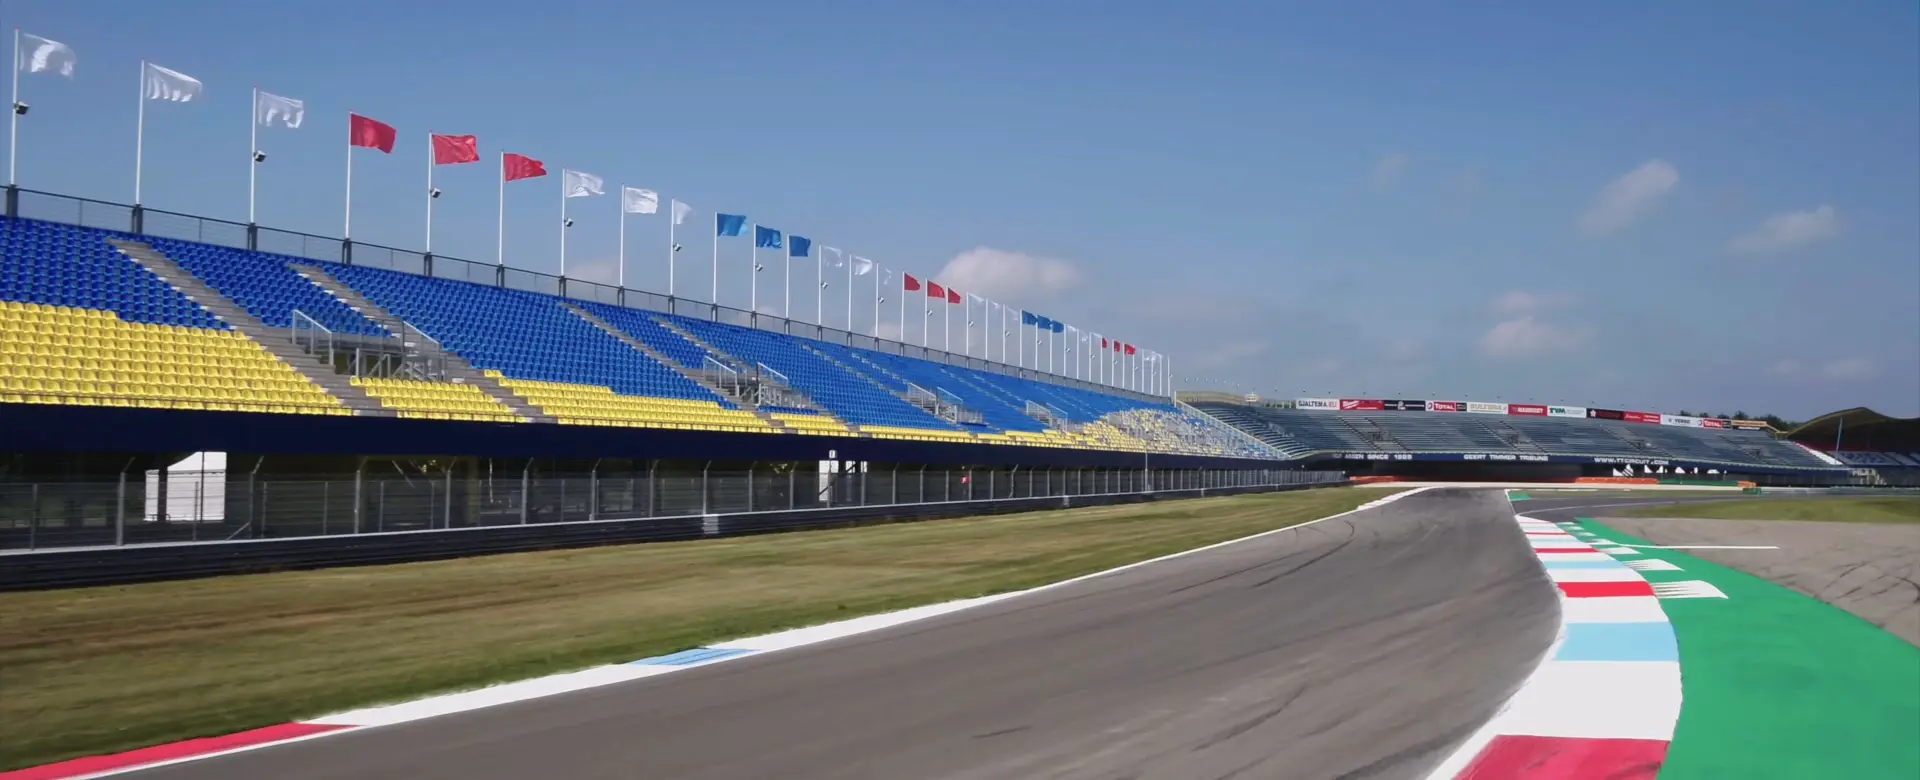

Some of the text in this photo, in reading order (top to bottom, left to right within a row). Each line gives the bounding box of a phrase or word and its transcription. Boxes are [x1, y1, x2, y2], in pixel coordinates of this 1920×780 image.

[1298, 400, 1337, 408] GJALTEMA.EU
[1435, 402, 1455, 410] TOTAL
[1703, 420, 1721, 428] TOTAL
